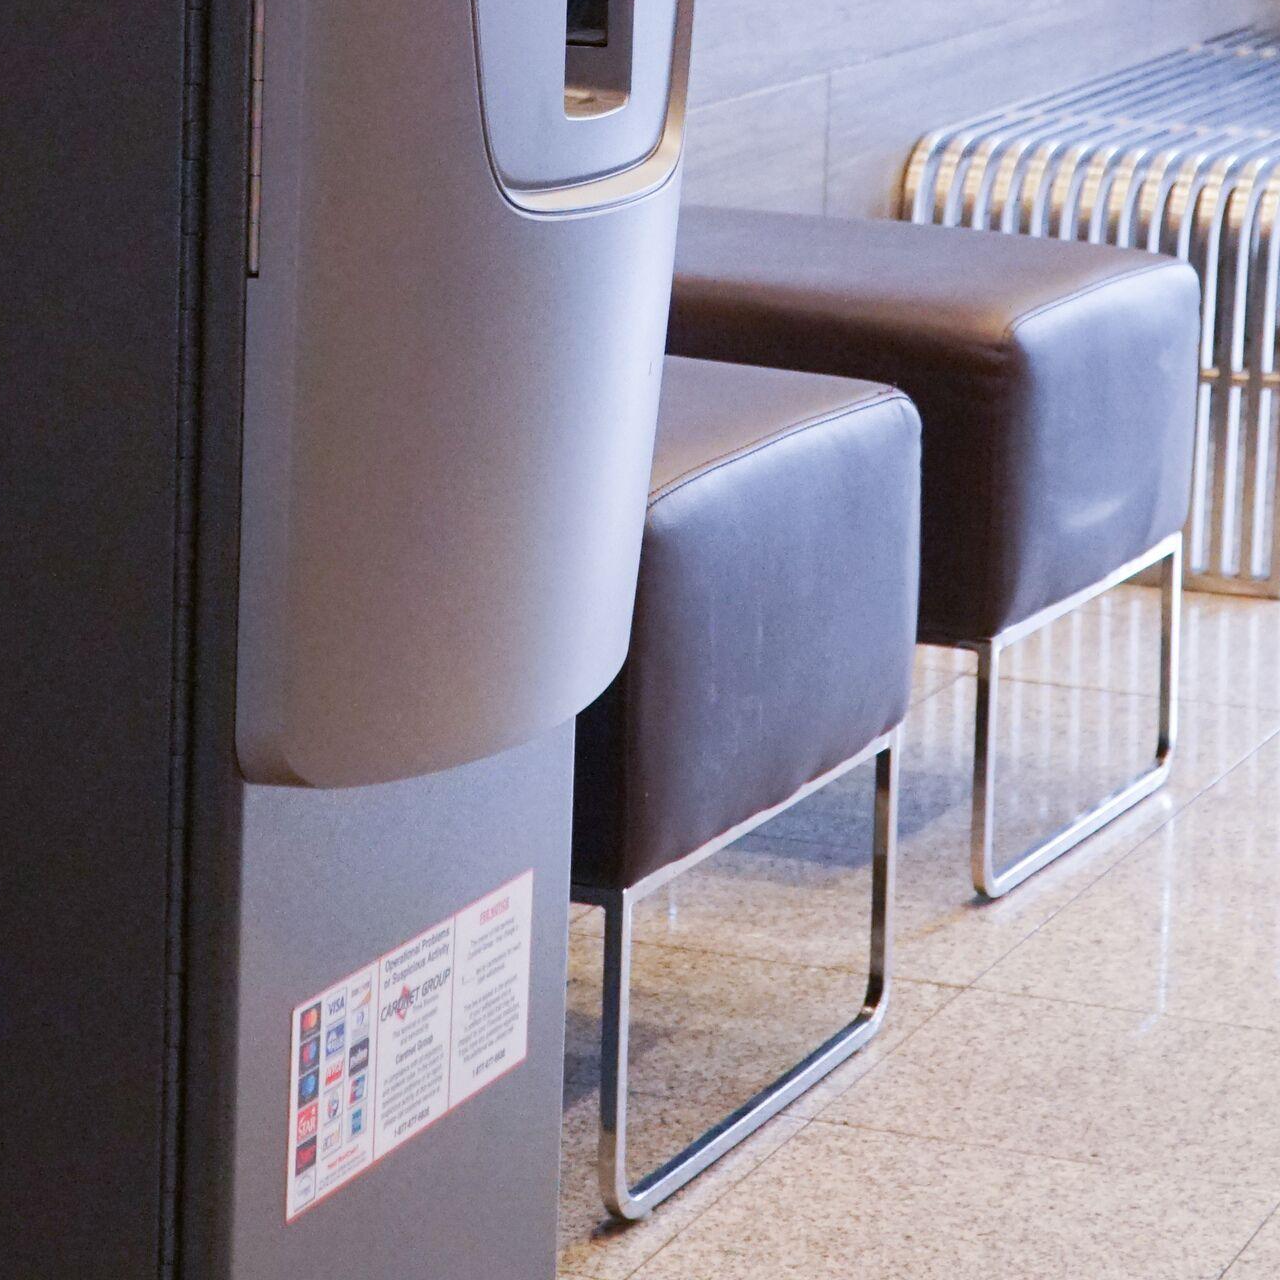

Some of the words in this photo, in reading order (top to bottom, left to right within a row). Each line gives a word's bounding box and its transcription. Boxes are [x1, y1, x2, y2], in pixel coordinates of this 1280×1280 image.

[421, 968, 451, 997] GROUP
[328, 995, 345, 1016] VISA
[297, 1117, 316, 1138] STAR
